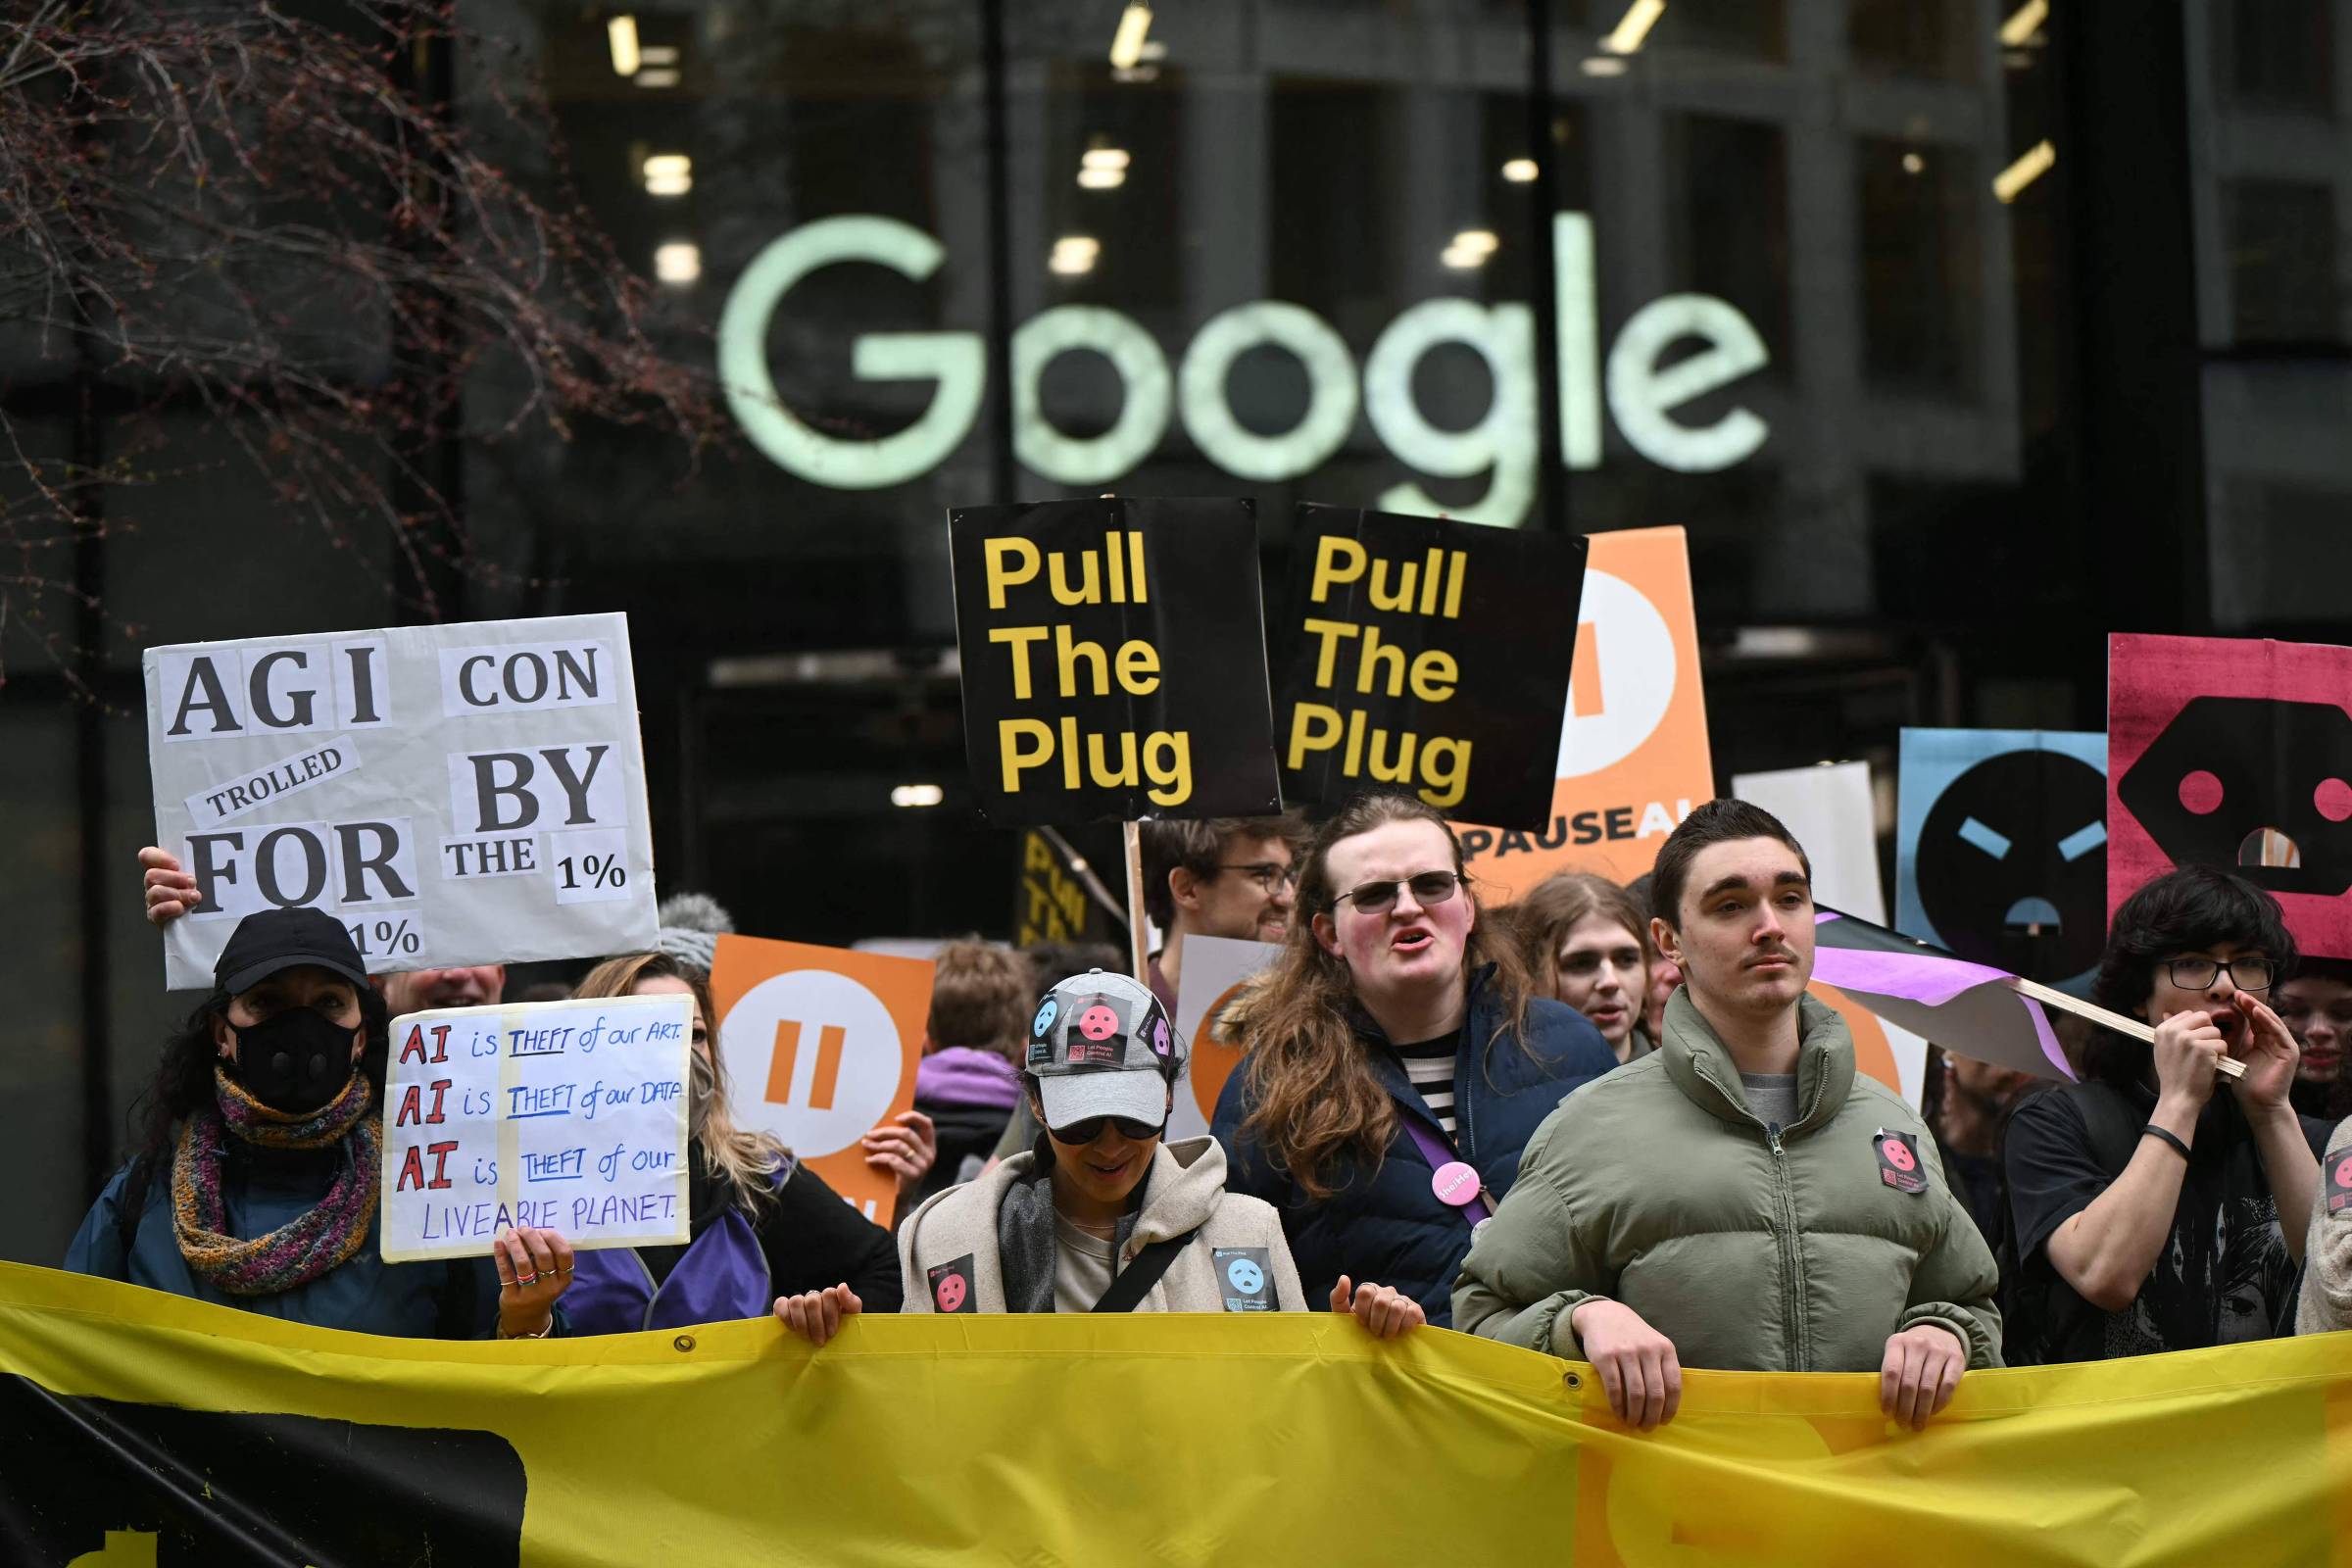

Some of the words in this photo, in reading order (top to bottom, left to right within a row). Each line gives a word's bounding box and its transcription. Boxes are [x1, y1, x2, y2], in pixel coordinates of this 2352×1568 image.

[718, 213, 1768, 529] Google
[984, 531, 1148, 610] Pull
[1311, 535, 1467, 619] Pull
[458, 647, 598, 708] CON
[989, 624, 1160, 699] The
[1303, 618, 1459, 703] The
[206, 746, 342, 817] TROLLED
[467, 745, 610, 833] BY
[999, 716, 1193, 807] Plug
[1287, 702, 1472, 808] Plug
[185, 821, 415, 914] FOR
[445, 837, 536, 877] THE
[558, 853, 626, 890] 1%
[350, 918, 419, 956] 1%
[399, 1023, 452, 1065] AI
[470, 1032, 497, 1058] is
[508, 1027, 575, 1057] THEFT
[578, 1016, 606, 1054] of
[608, 1027, 642, 1046] our
[646, 1022, 684, 1043] ART.
[396, 1078, 453, 1128] AI
[463, 1088, 490, 1115] is
[506, 1084, 575, 1119] THEFT
[579, 1080, 605, 1120] of
[605, 1085, 635, 1104] our
[640, 1081, 682, 1105] DATA
[396, 1141, 459, 1193] AI
[473, 1161, 498, 1185] is
[520, 1147, 588, 1182] THEFT
[597, 1143, 626, 1182] of
[631, 1151, 676, 1171] our
[571, 1194, 677, 1227] PLANET.
